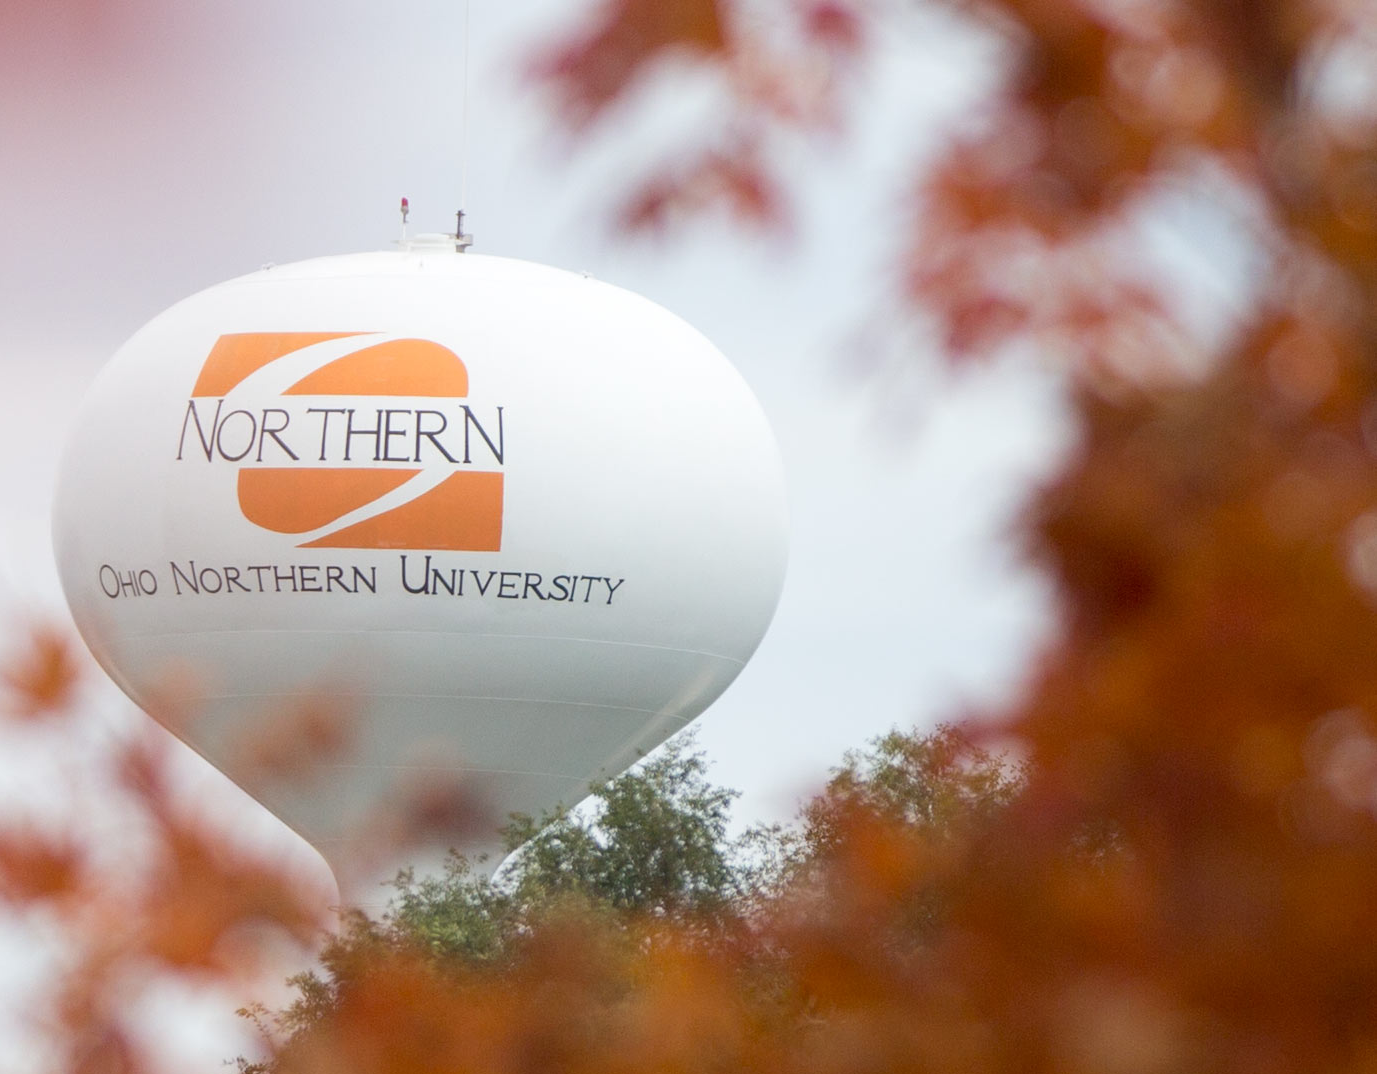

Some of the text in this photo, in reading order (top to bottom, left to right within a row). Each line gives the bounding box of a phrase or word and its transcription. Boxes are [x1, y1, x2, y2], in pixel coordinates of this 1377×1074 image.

[175, 398, 505, 466] NORTHERN
[98, 555, 625, 605] OHIO NORTHERN UNIVERSITY
